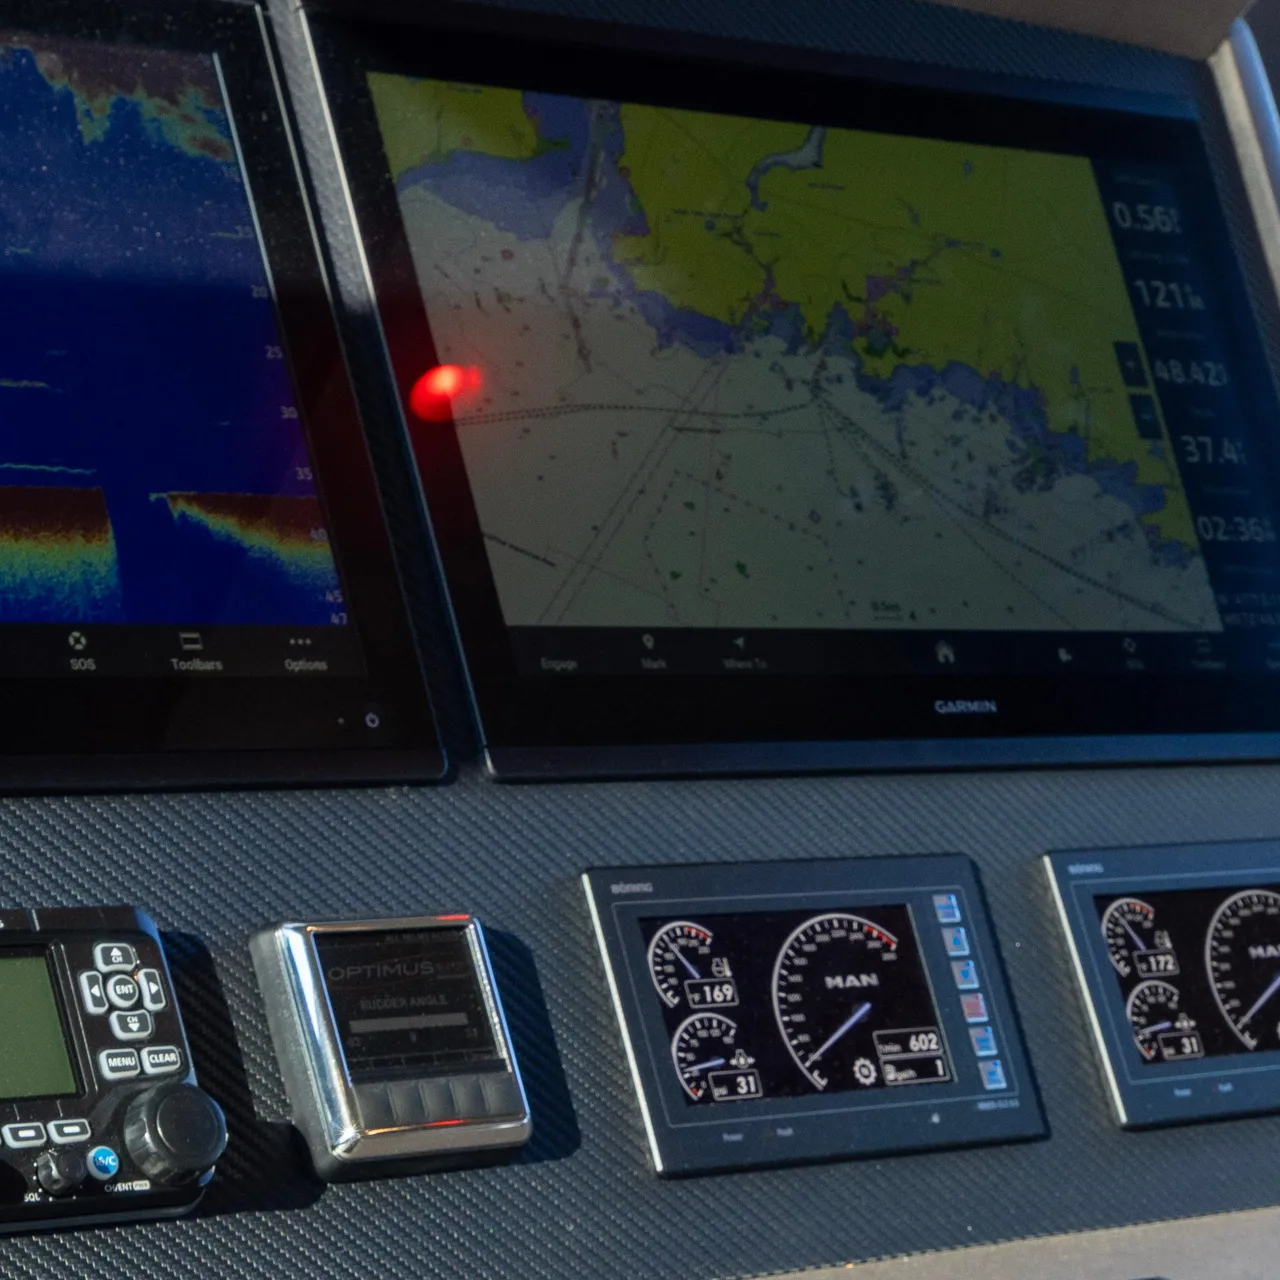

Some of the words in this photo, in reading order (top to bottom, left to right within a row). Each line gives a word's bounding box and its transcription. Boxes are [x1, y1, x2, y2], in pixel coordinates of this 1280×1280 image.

[295, 467, 313, 481] 35
[70, 658, 96, 671] SOS
[171, 657, 222, 671] Toolbars
[285, 658, 327, 673] Options
[933, 698, 998, 715] GARMIN
[111, 955, 123, 964] CH
[1148, 954, 1176, 972] 172
[327, 961, 434, 981] OPTIMUS
[824, 972, 880, 990] MAN
[115, 984, 134, 995] ENT
[703, 983, 734, 1003] 169
[360, 996, 406, 1011] RUDDER
[409, 994, 448, 1007] ANGLE
[126, 1016, 139, 1024] CH
[909, 1032, 939, 1052] 602
[1180, 1037, 1199, 1054] 31
[107, 1056, 136, 1067] MENU
[149, 1052, 177, 1064] CLEAR
[934, 1058, 945, 1077] 1
[736, 1075, 757, 1094] 31
[104, 1181, 133, 1193] CH/ENT
[23, 1194, 41, 1204] SQL
